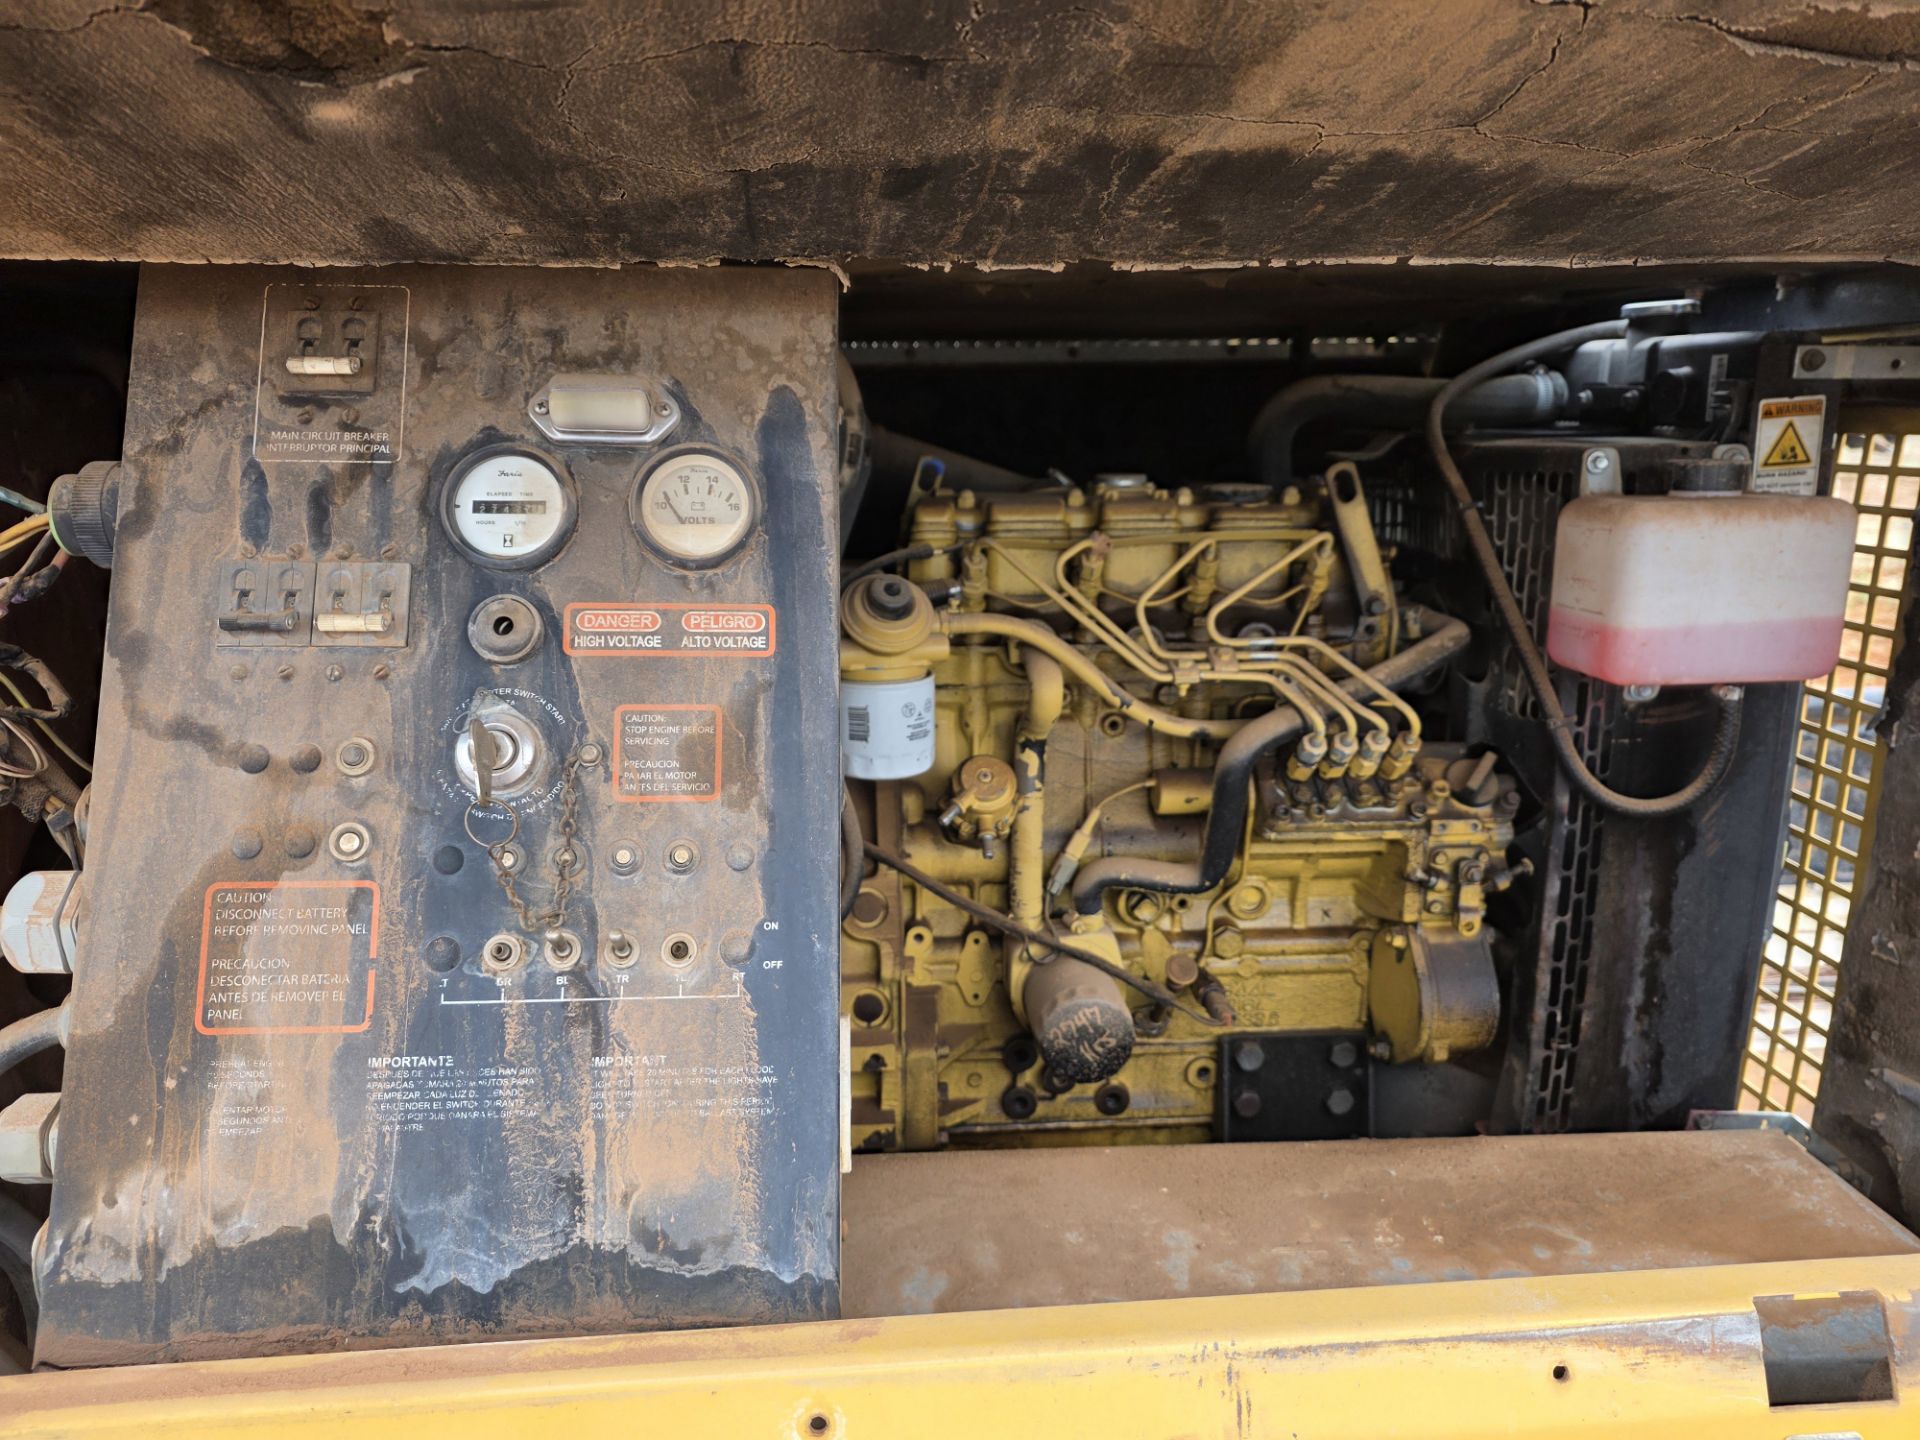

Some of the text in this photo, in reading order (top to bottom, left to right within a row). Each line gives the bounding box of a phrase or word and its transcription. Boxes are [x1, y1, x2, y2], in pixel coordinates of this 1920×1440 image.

[271, 431, 390, 442] MAIN CIRCUIT BREAKER
[339, 443, 391, 454] PRINCIPAL
[679, 475, 690, 483] 12
[706, 476, 718, 484] 14
[655, 502, 667, 510] 10
[728, 503, 740, 511] 16
[681, 516, 715, 525] VOLTS
[584, 614, 652, 628] DANGER
[690, 615, 756, 629] PELIGRO
[574, 635, 662, 648] HIGH VOLTAGE
[681, 636, 766, 649] ALTO VOLTAGE
[514, 688, 547, 705] SWITCH
[625, 725, 715, 734] STOP ENGINE BEFORE
[625, 737, 670, 745] SERVICING
[624, 771, 697, 780] PAAR EL MOTOR
[672, 782, 710, 791] SERVICIO
[217, 892, 273, 904] CAUTION
[296, 907, 348, 919] BATTERY
[331, 923, 369, 935] PANEL
[763, 922, 779, 930] ON
[212, 958, 290, 970] PRECAUCION
[763, 961, 783, 969] OFF
[616, 974, 630, 983] TR
[732, 972, 746, 981] RT
[208, 991, 248, 1004] ANTES
[252, 991, 267, 1002] DE
[332, 990, 346, 1002] EL
[368, 1055, 454, 1068] IMPORTANTE
